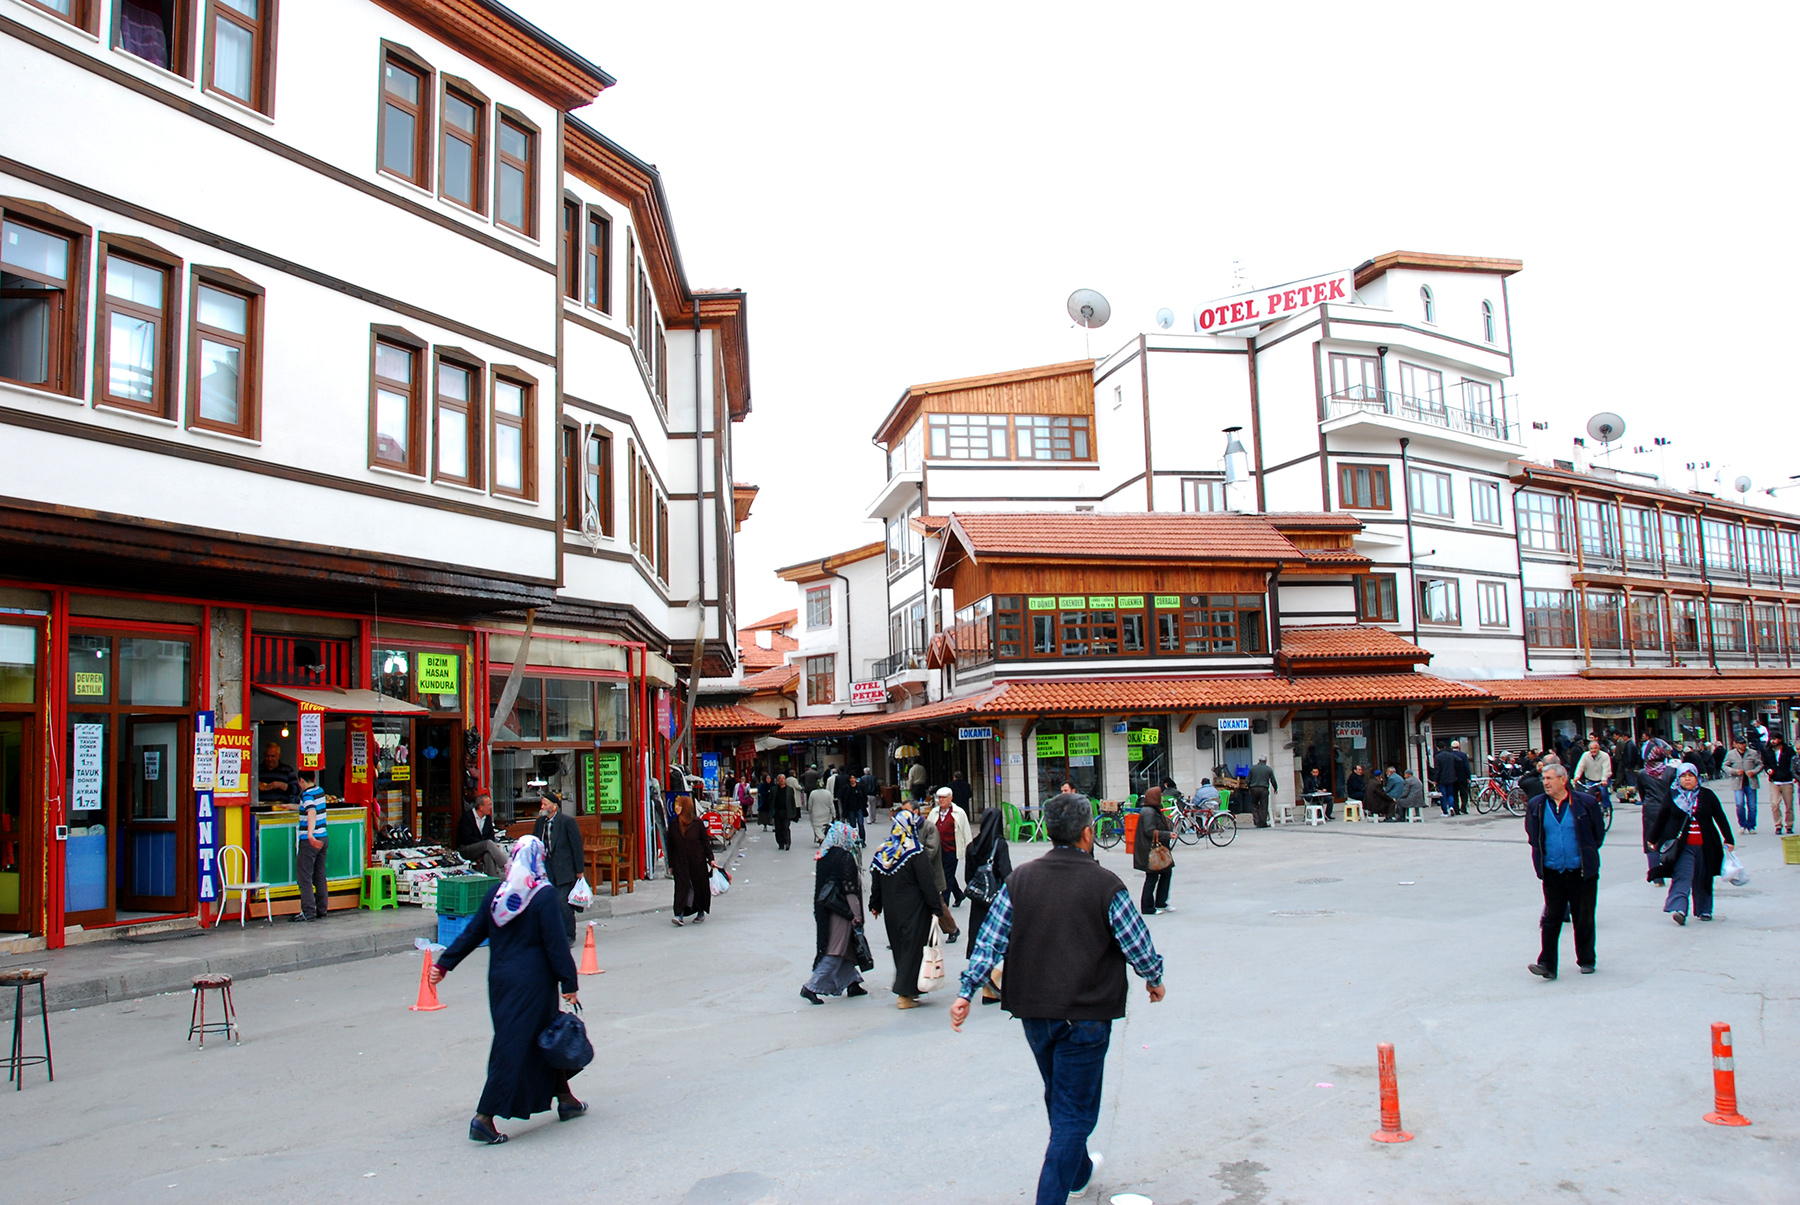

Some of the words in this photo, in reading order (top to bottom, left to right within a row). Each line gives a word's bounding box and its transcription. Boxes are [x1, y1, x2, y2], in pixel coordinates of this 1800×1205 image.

[1199, 299, 1260, 330] OTEL
[1267, 278, 1346, 314] PETEK
[428, 656, 448, 666] BİZİM
[76, 673, 103, 683] DEVREN
[426, 668, 449, 678] HASAN
[76, 684, 102, 694] SATILIK
[420, 680, 454, 690] KUNDURA
[854, 682, 880, 690] OTEL
[852, 690, 884, 700] PETEK
[1219, 720, 1248, 729] LOKANTA
[960, 728, 991, 738] LOKANTA
[1128, 732, 1142, 743] OKA
[214, 734, 250, 746] TAVUK
